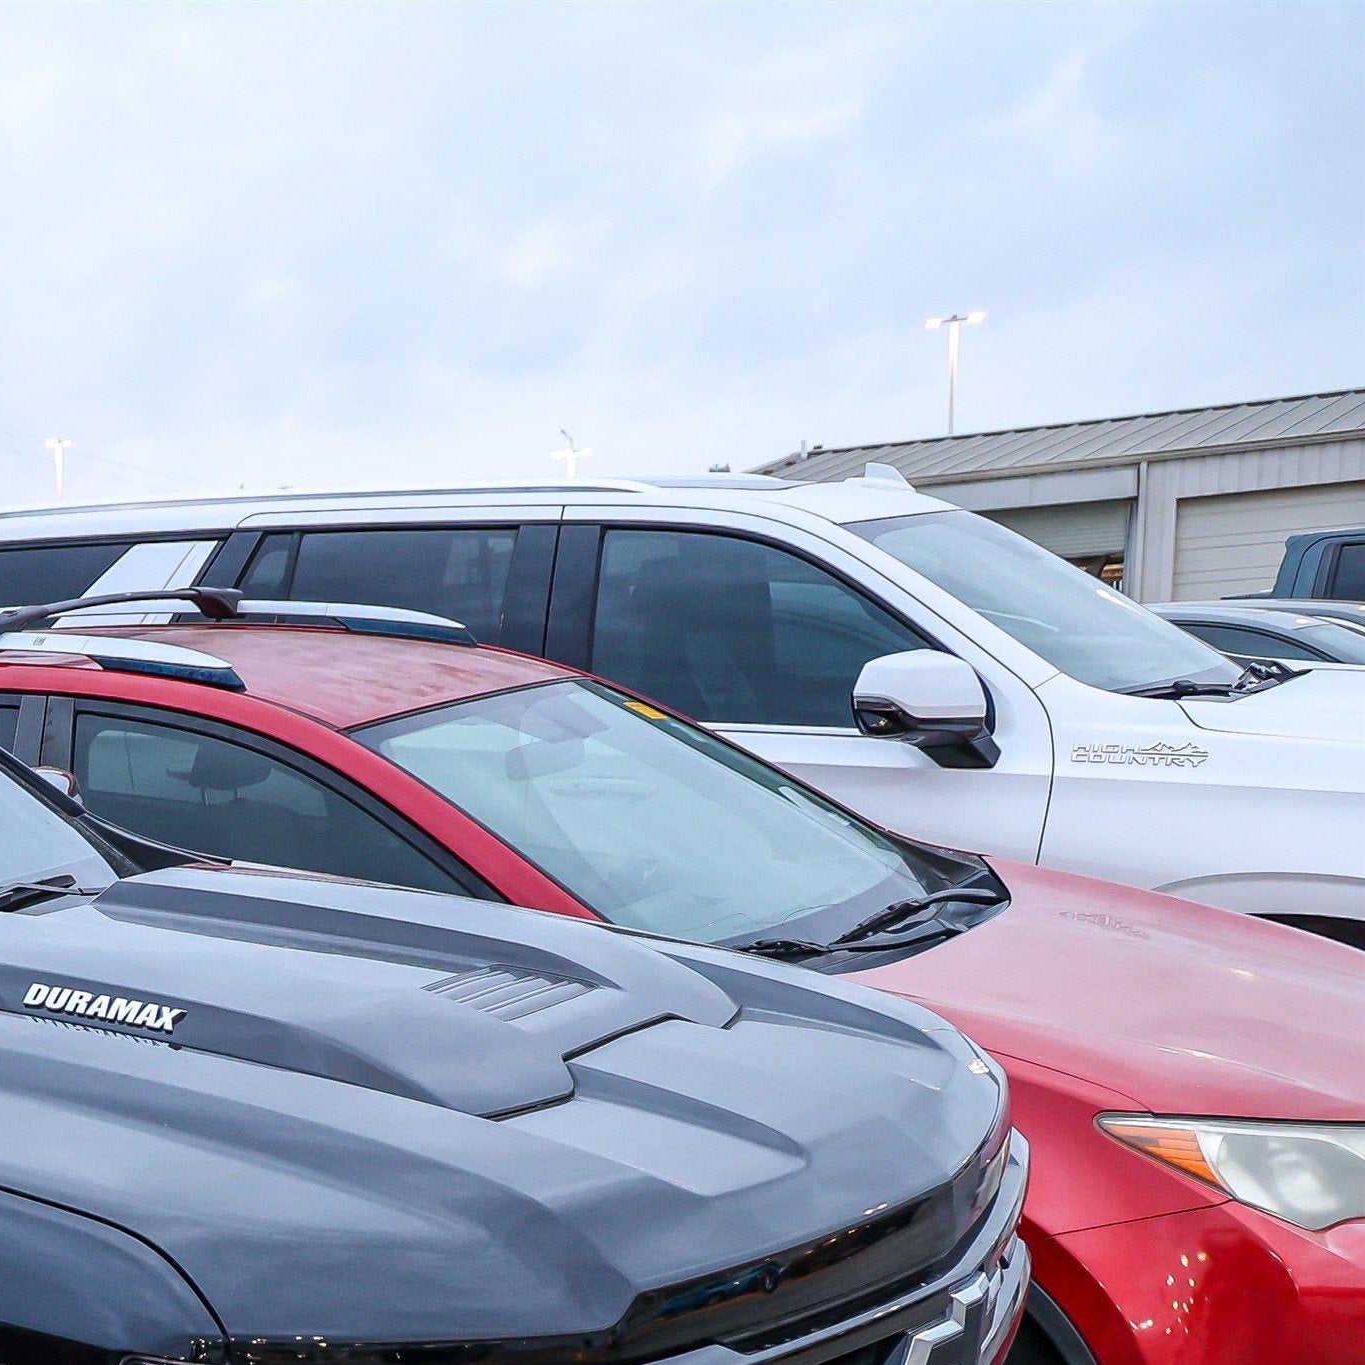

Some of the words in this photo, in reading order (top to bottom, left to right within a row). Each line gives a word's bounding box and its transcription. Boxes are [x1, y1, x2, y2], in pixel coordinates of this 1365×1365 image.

[1072, 742, 1142, 754] HIGH
[1071, 753, 1208, 767] COUNTRY
[22, 982, 187, 1034] DURAMAX
